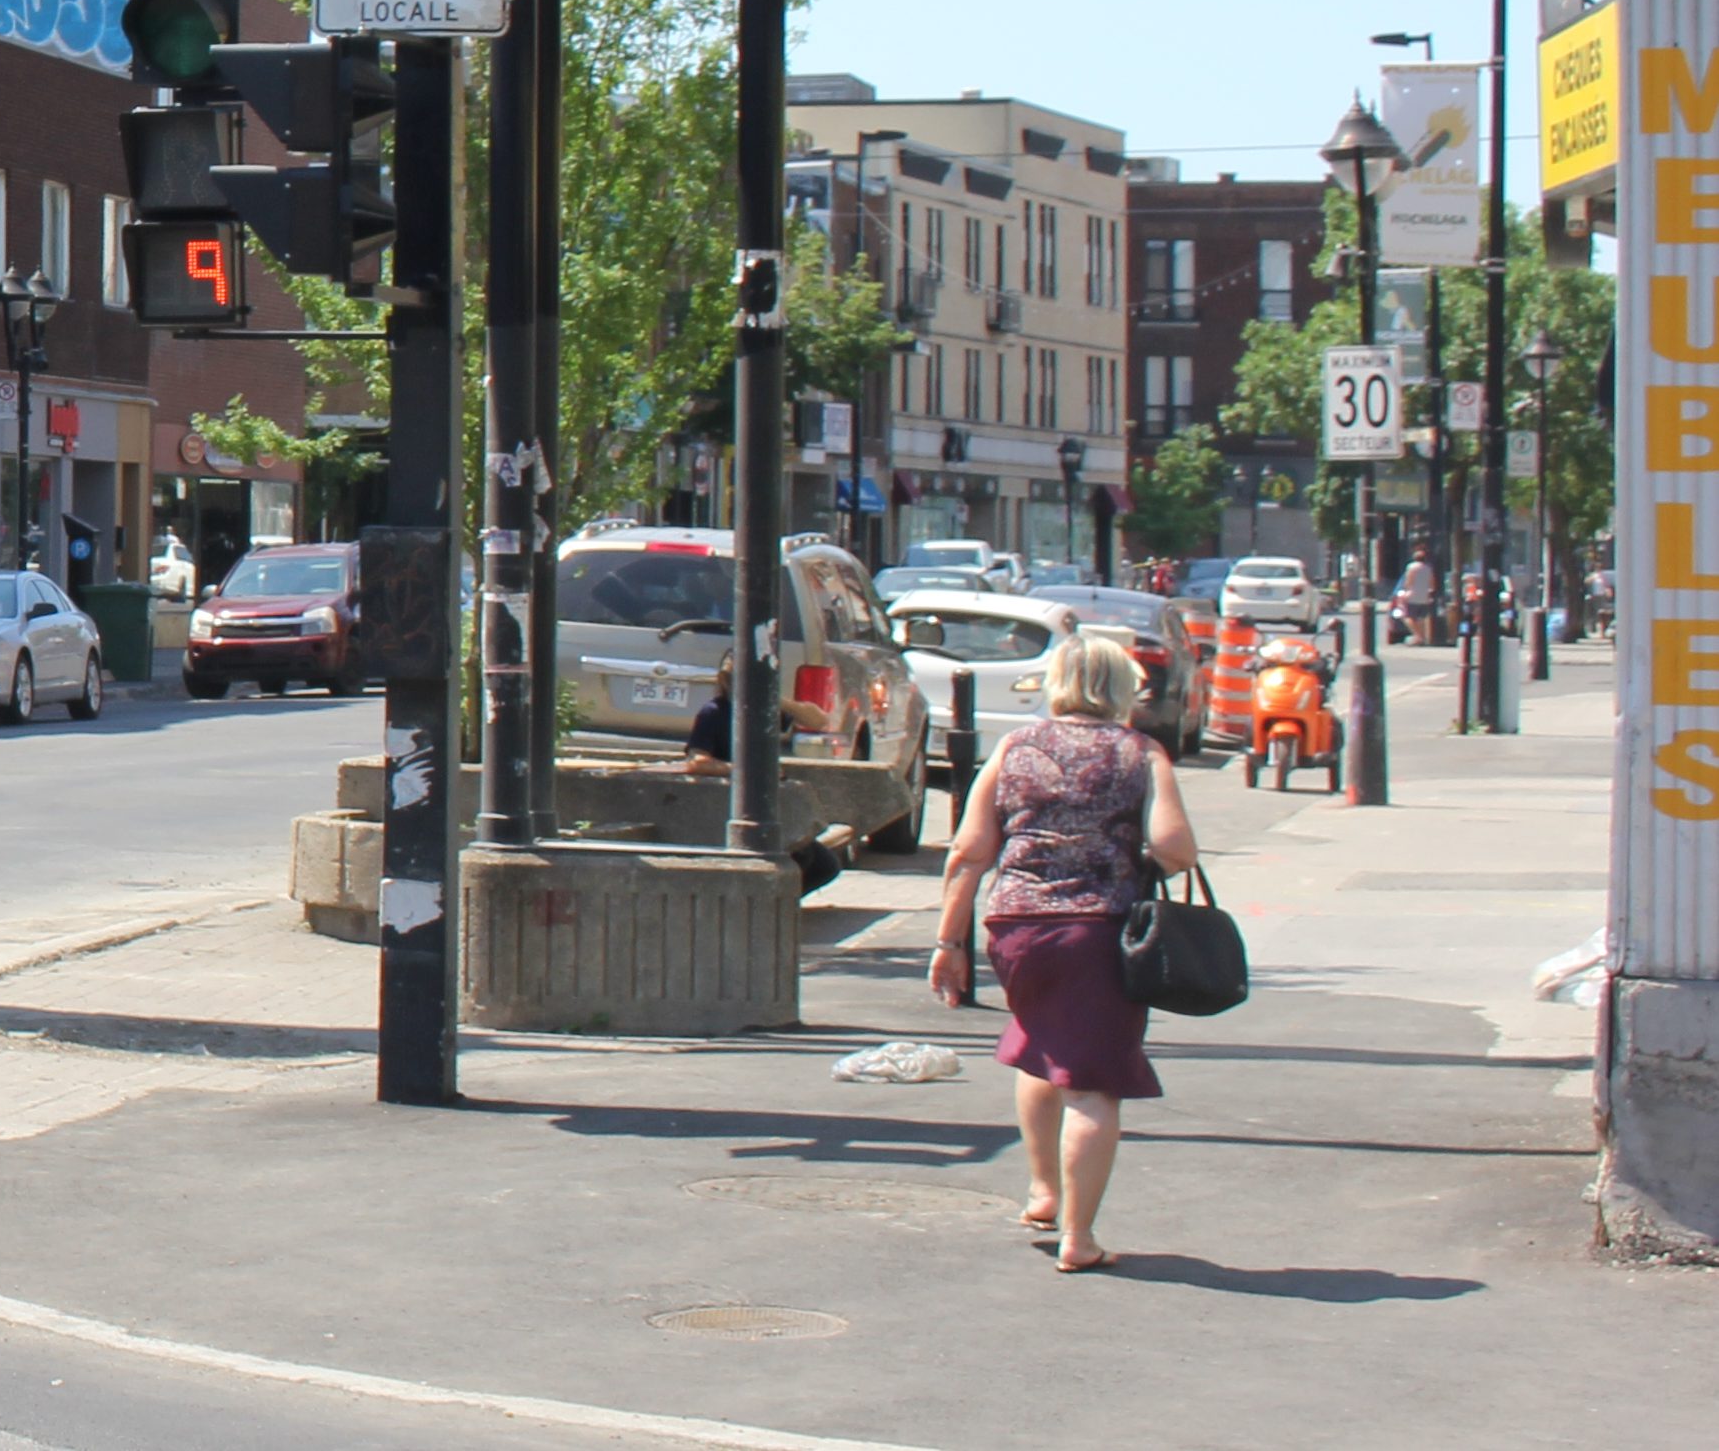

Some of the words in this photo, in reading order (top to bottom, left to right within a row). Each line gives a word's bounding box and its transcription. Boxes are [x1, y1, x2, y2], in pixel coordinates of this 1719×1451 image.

[361, 1, 459, 22] LOCALE
[188, 240, 226, 305] 9
[1331, 355, 1392, 367] MAXIMUM
[1335, 375, 1388, 428] 30
[1333, 437, 1390, 450] SECTEUR
[1639, 47, 1719, 821] MEUBLES
